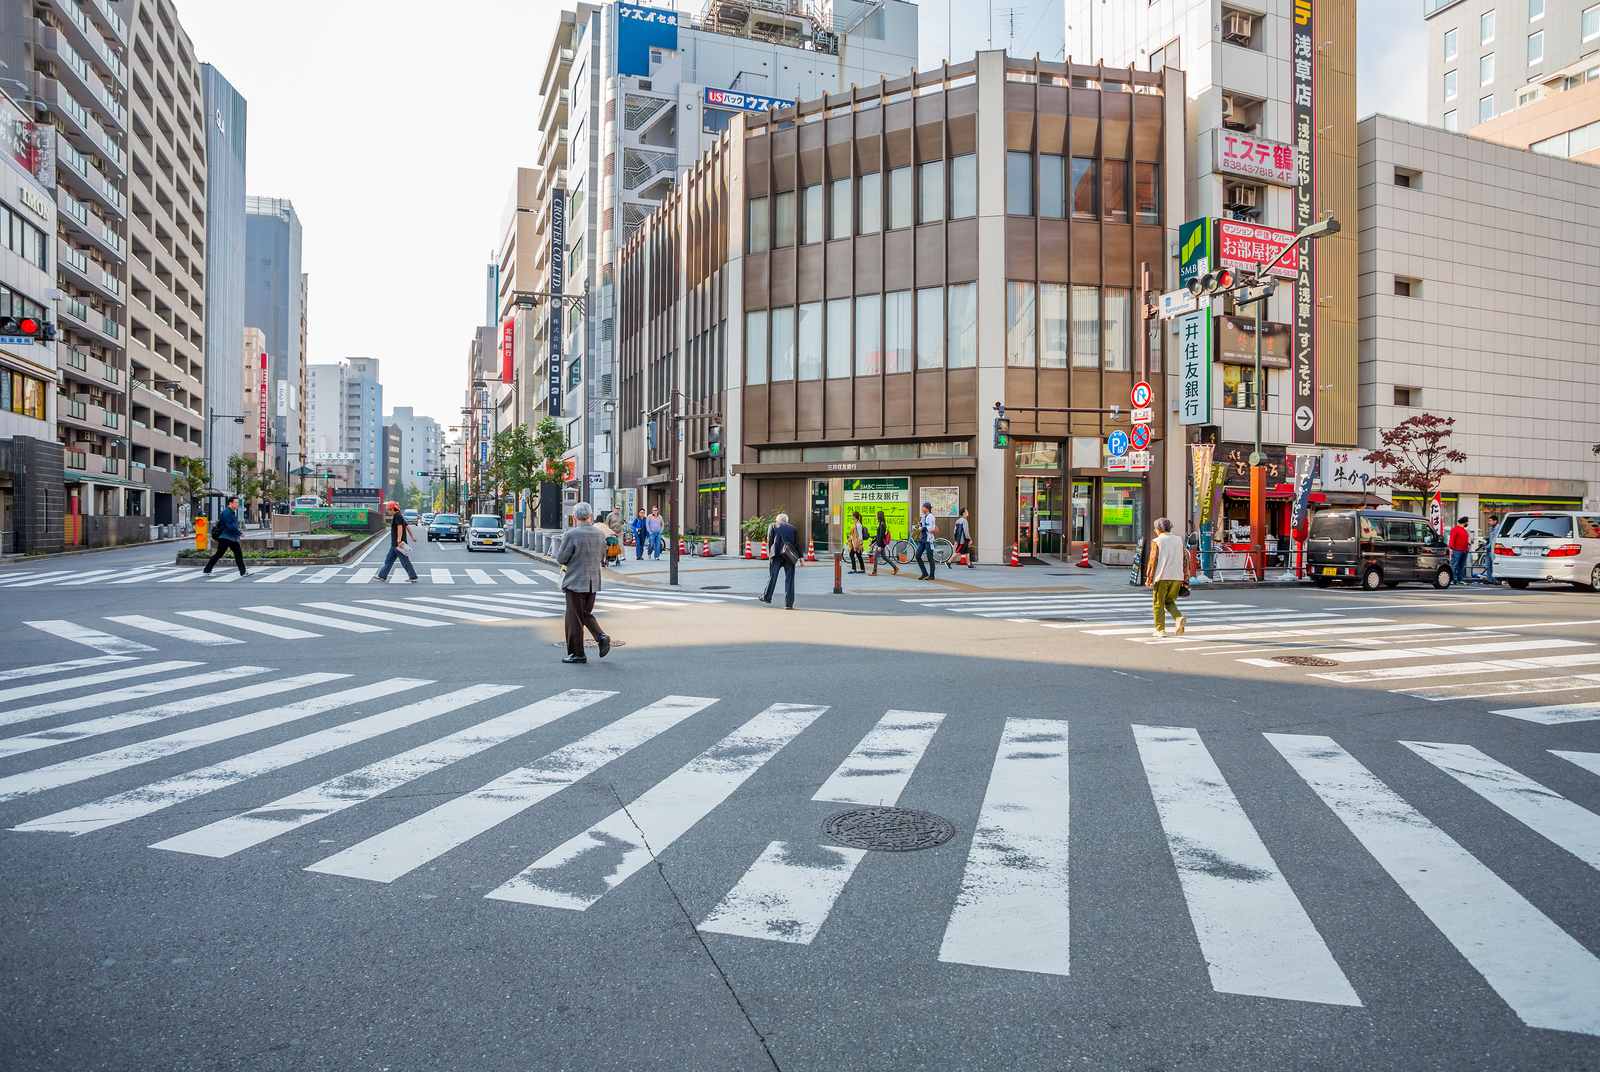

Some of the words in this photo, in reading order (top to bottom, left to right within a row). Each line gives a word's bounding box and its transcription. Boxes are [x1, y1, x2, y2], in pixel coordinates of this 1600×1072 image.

[1295, 33, 1312, 107] 浅草店
[1223, 135, 1294, 171] エステ鶴
[553, 198, 563, 246] CROSTER
[1180, 263, 1199, 277] SMB
[853, 492, 900, 501] 三井住友銀行
